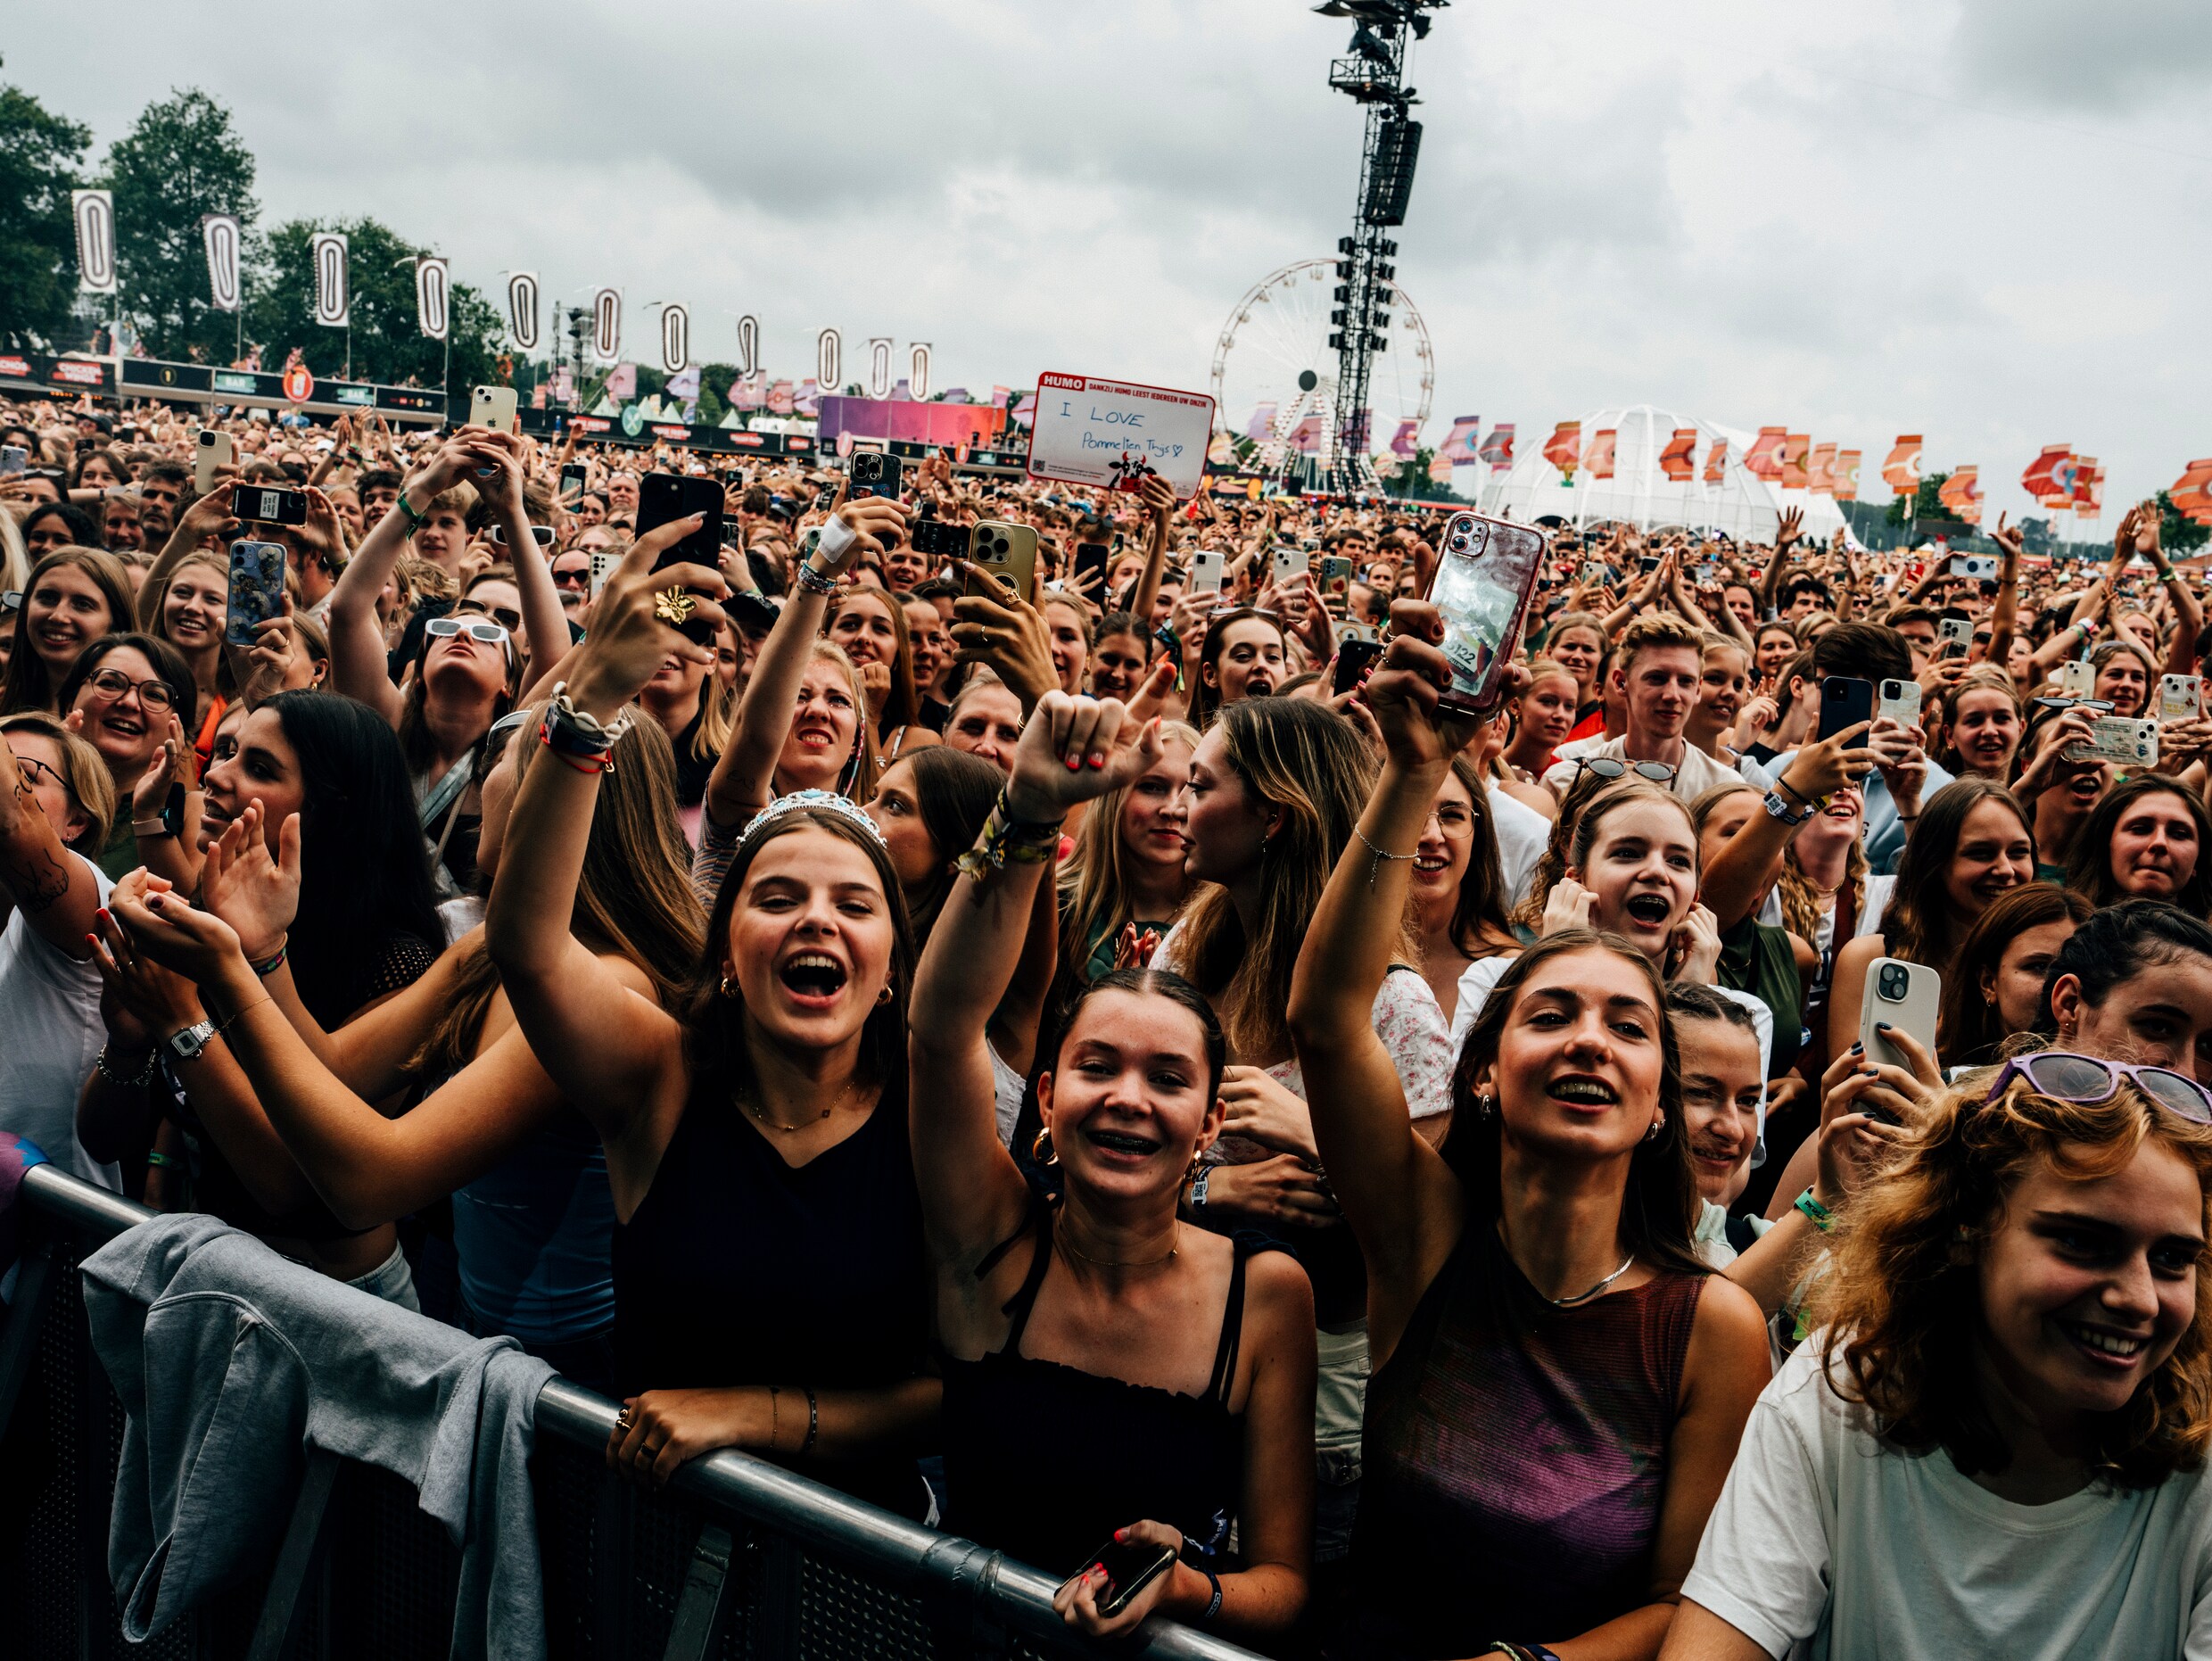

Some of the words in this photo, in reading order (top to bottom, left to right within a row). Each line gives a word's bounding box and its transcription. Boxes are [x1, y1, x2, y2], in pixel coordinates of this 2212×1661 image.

[59, 362, 102, 376] CHICKEN
[225, 376, 246, 388] BAR
[1044, 376, 1083, 390] HUMO
[346, 389, 366, 400] BAR
[1088, 383, 1114, 393] DANKZIJ
[1114, 386, 1131, 395] HUMO
[1132, 390, 1150, 399] LEEST
[1151, 393, 1178, 402] IEDEREEN
[1189, 400, 1207, 409] ONZIN
[1061, 402, 1071, 417] I
[1090, 407, 1145, 427] LOVE
[1082, 431, 1141, 450] Pommelien
